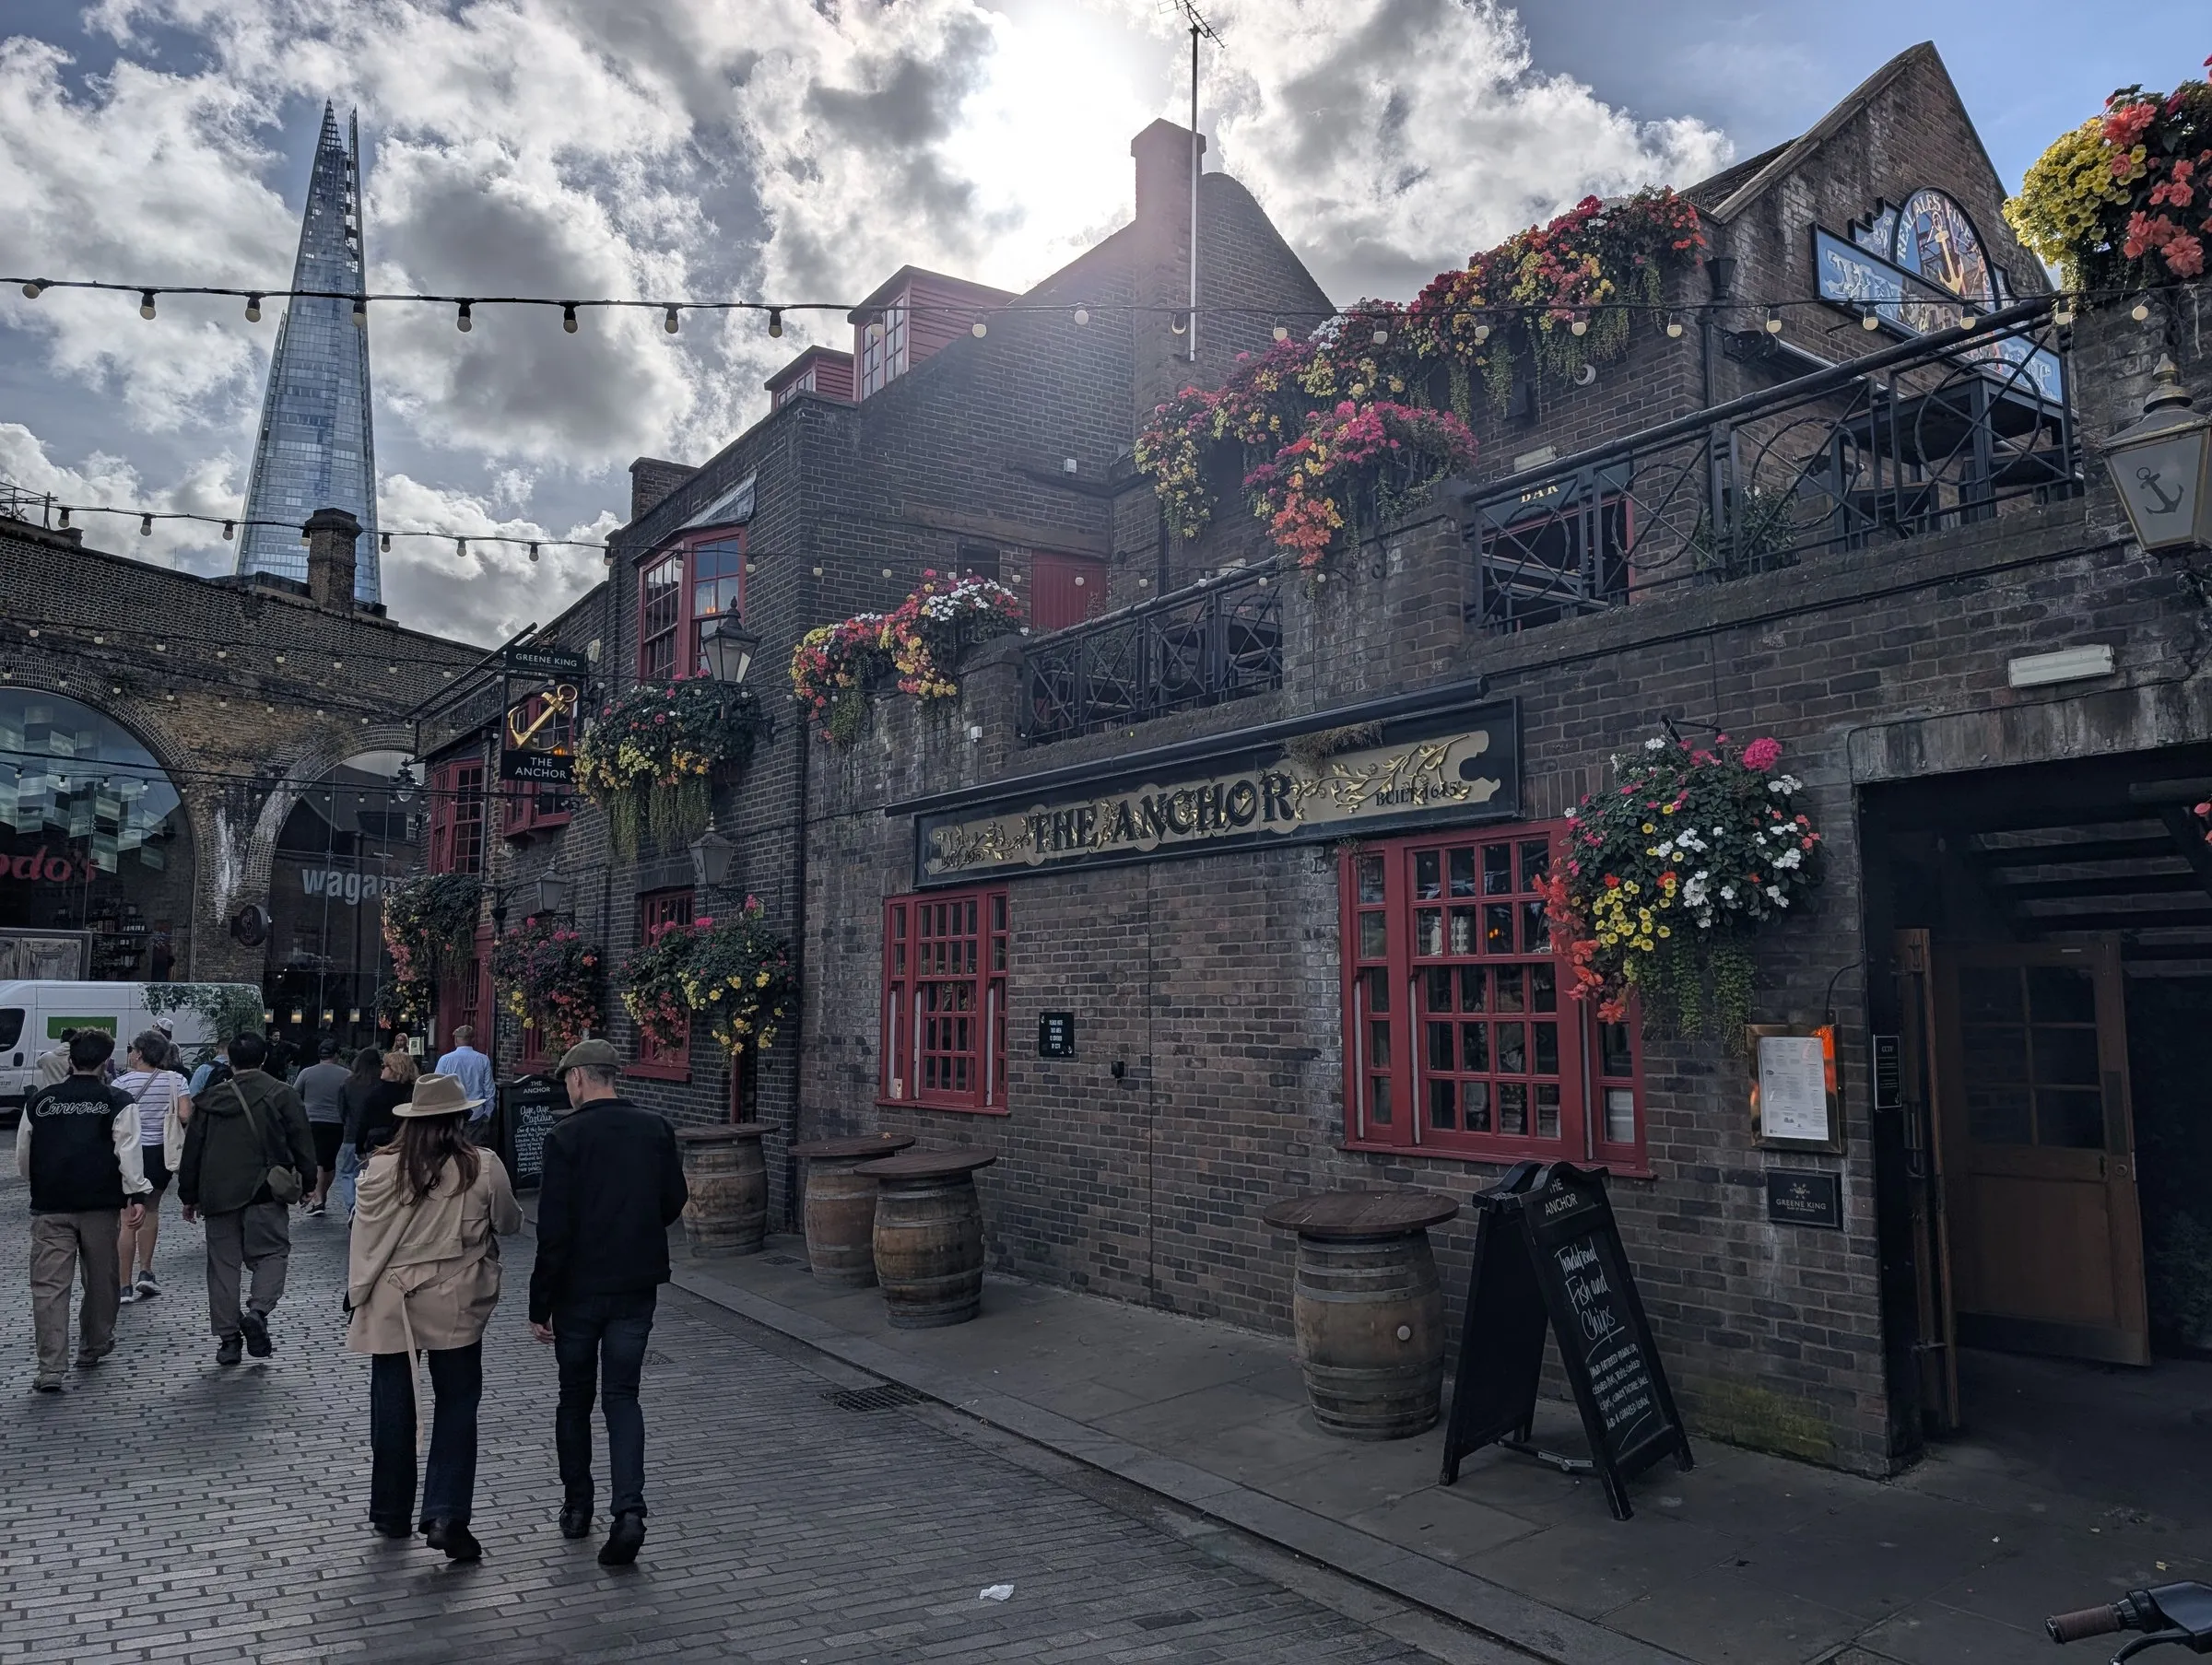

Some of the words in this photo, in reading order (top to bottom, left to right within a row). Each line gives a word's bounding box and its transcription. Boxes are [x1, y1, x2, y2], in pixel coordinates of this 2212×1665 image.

[1897, 211, 1916, 261] REAL
[515, 652, 551, 664] GREENE
[554, 657, 577, 667] KING
[530, 756, 553, 767] THE
[514, 767, 567, 779] ANCHOR
[1375, 787, 1417, 806] BUILT
[1028, 803, 1098, 853] THE
[1112, 770, 1298, 844] ANCHOR
[35, 1096, 111, 1117] Converse
[1545, 1192, 1578, 1216] ANCHOR
[1775, 1198, 1806, 1208] GREENE
[1806, 1202, 1827, 1210] KING
[1554, 1236, 1600, 1278] Traditional
[1565, 1275, 1594, 1315] Fish
[1590, 1264, 1612, 1296] and
[1581, 1305, 1616, 1343] Chips
